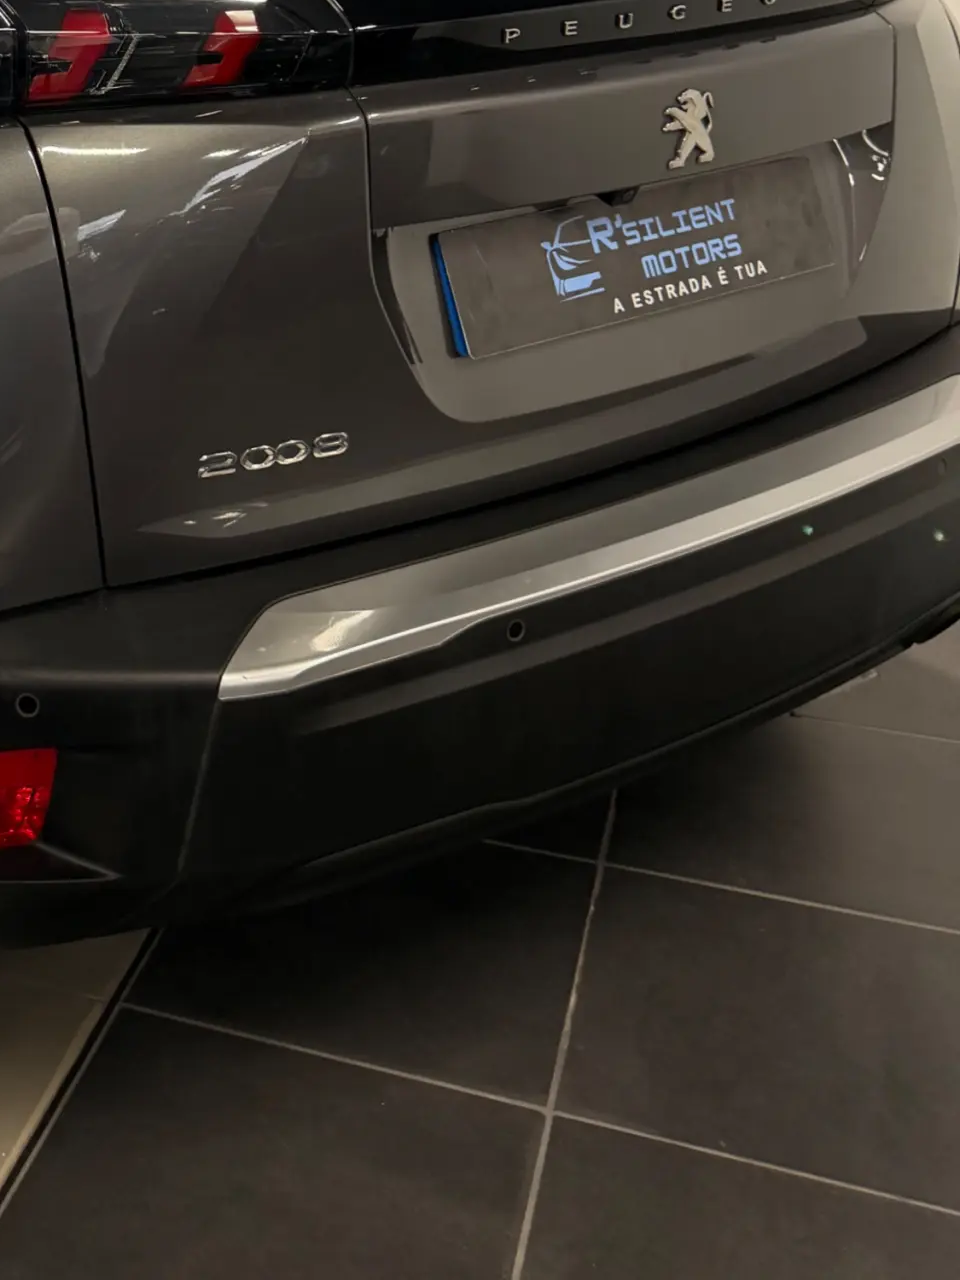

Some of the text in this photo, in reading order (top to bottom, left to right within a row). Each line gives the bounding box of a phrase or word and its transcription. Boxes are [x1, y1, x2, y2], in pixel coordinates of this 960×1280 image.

[641, 234, 743, 278] MOTORS
[613, 260, 768, 313] A ESTRADA É TUA
[198, 431, 349, 478] 2008
